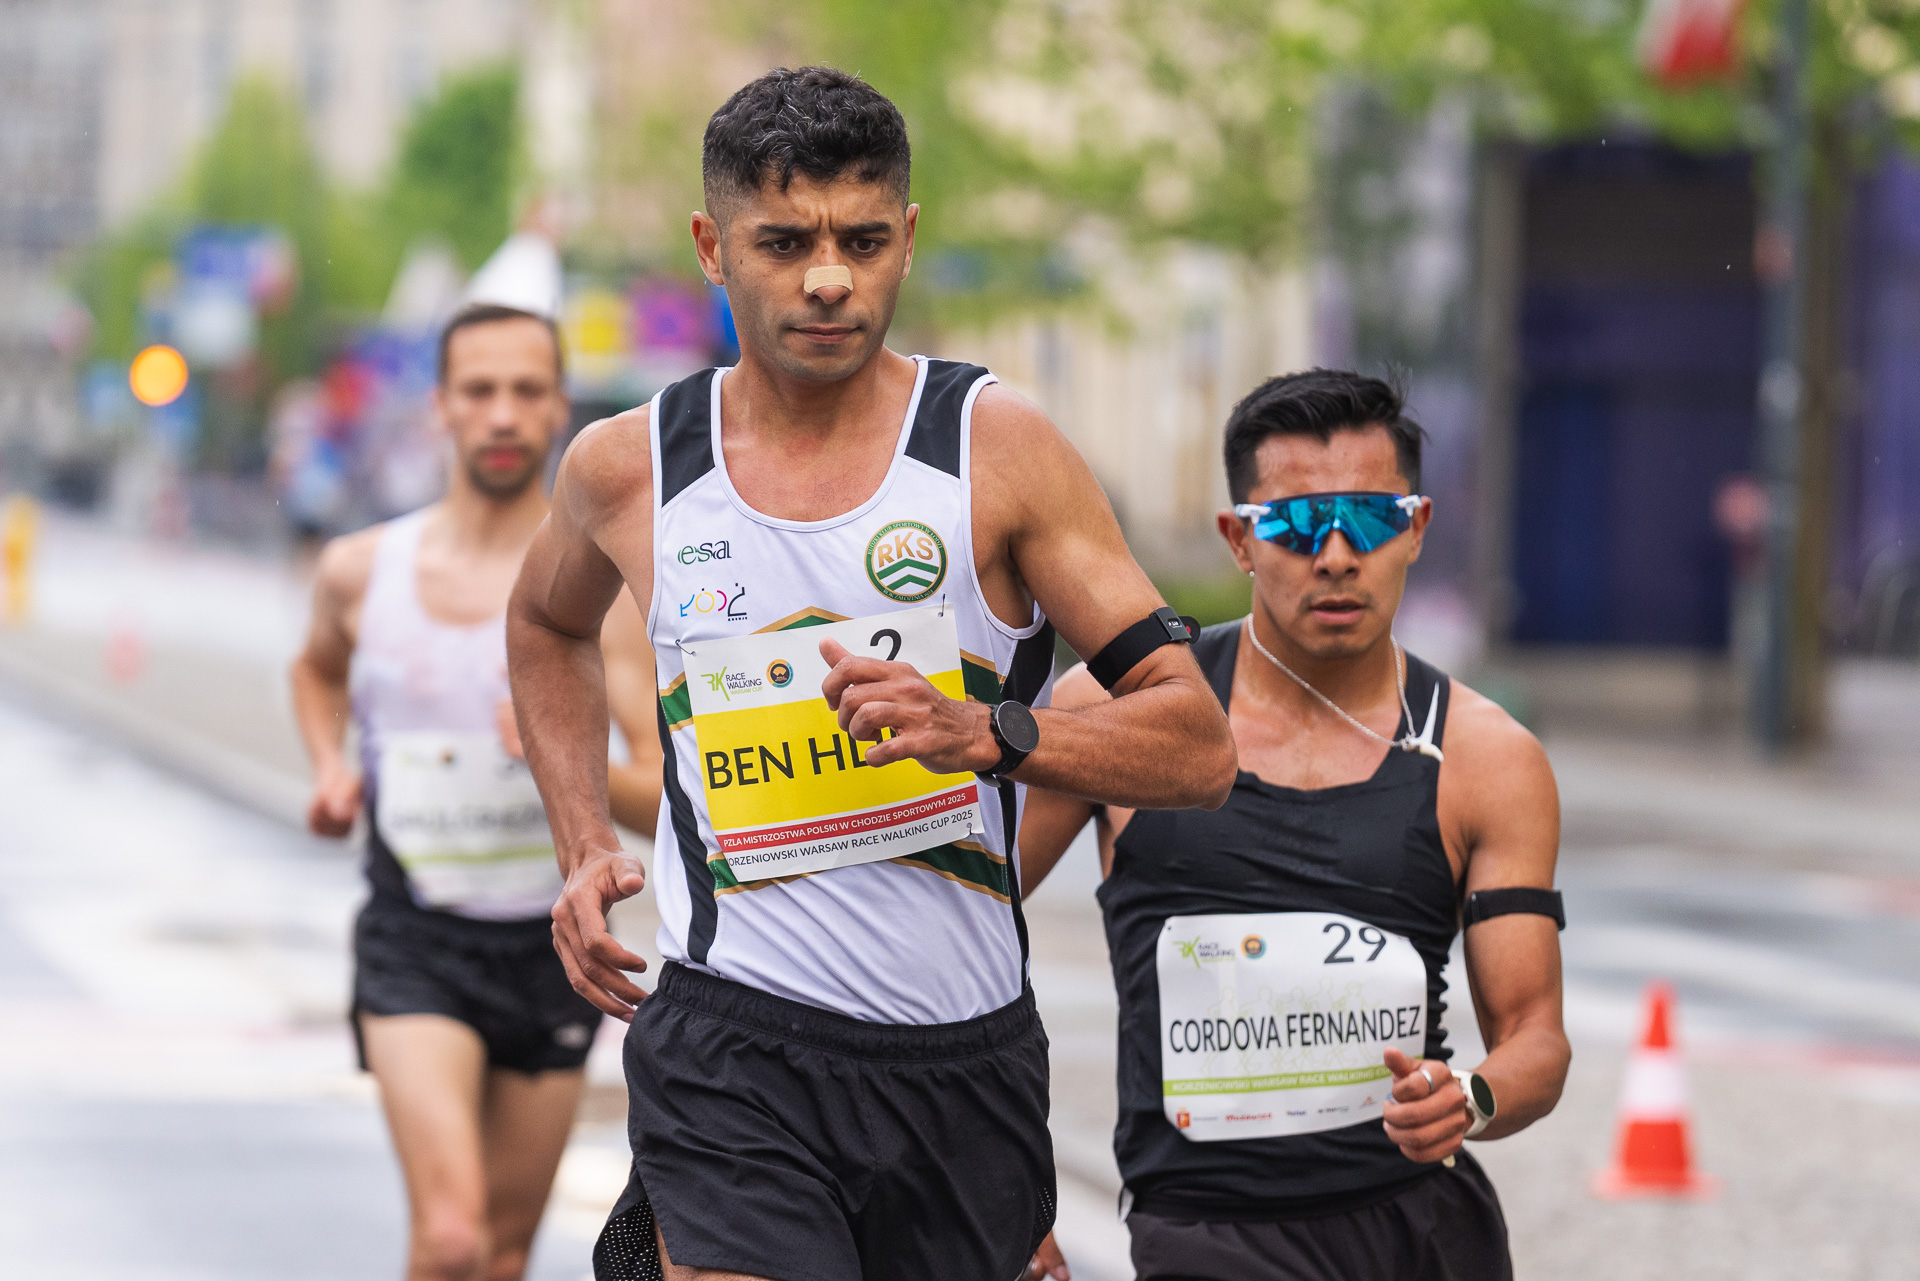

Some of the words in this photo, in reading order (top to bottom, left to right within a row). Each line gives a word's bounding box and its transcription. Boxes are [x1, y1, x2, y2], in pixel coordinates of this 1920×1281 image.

[878, 532, 933, 568] RKS
[869, 628, 902, 662] 2
[725, 672, 746, 682] RACE
[726, 678, 762, 690] WALKING
[705, 741, 794, 790] BEN
[723, 835, 742, 847] PZLA
[743, 828, 806, 845] MISTRZOSTWA
[807, 823, 838, 835] POLSKI
[839, 821, 850, 830] W
[850, 813, 892, 828] CHODZIE
[892, 799, 946, 820] SPORTOWYM
[947, 792, 966, 805] 2025
[799, 840, 849, 856] WARSAW
[851, 835, 880, 849] RACE
[881, 823, 929, 842] WALKING
[930, 817, 949, 829] CUP
[951, 809, 973, 824] 2025
[1322, 922, 1387, 964] 29
[1169, 1016, 1281, 1054] CORDOVA
[1286, 1005, 1421, 1048] FERNANDEZ
[1252, 1076, 1298, 1088] WARSAW
[1299, 1073, 1325, 1084] RACE
[1327, 1068, 1374, 1083] WALKING
